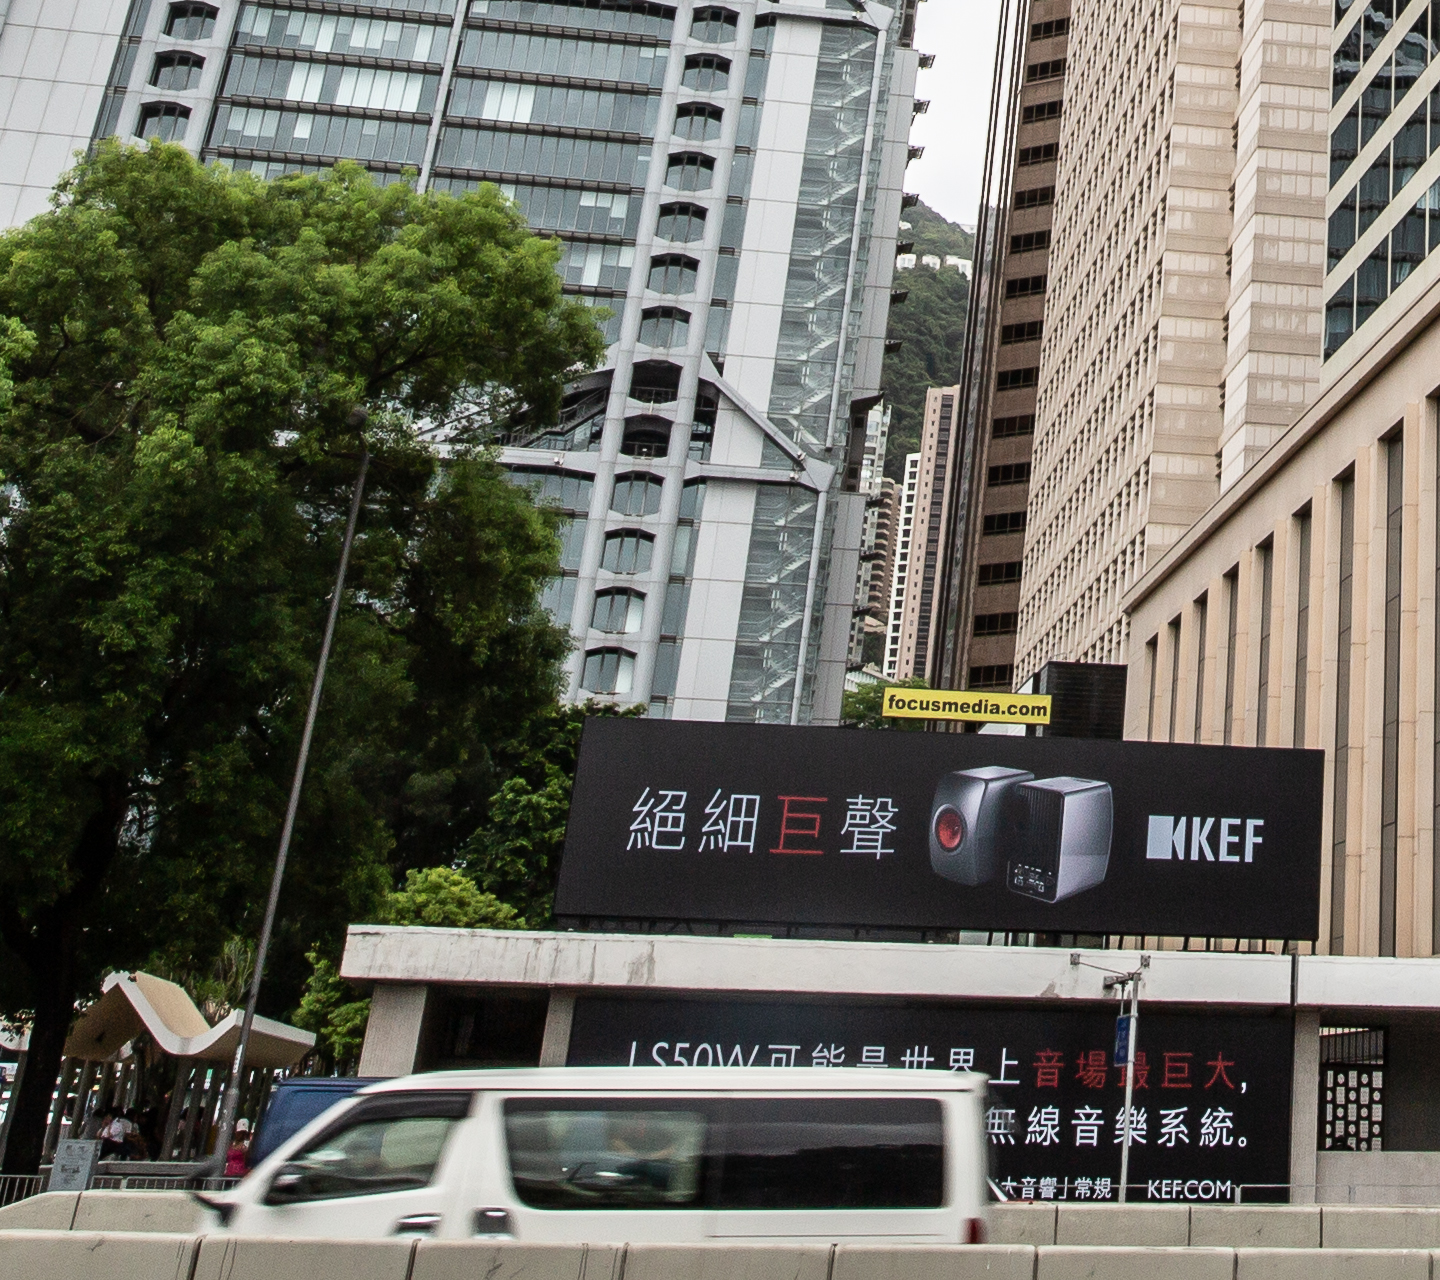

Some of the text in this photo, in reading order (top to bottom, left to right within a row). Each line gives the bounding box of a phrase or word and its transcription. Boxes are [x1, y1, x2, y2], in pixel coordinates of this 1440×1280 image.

[887, 693, 1048, 717] focusmedia.com
[625, 786, 899, 860] 絕細巨聲
[1190, 816, 1264, 862] KEF
[1146, 1179, 1232, 1200] KEF.COM
